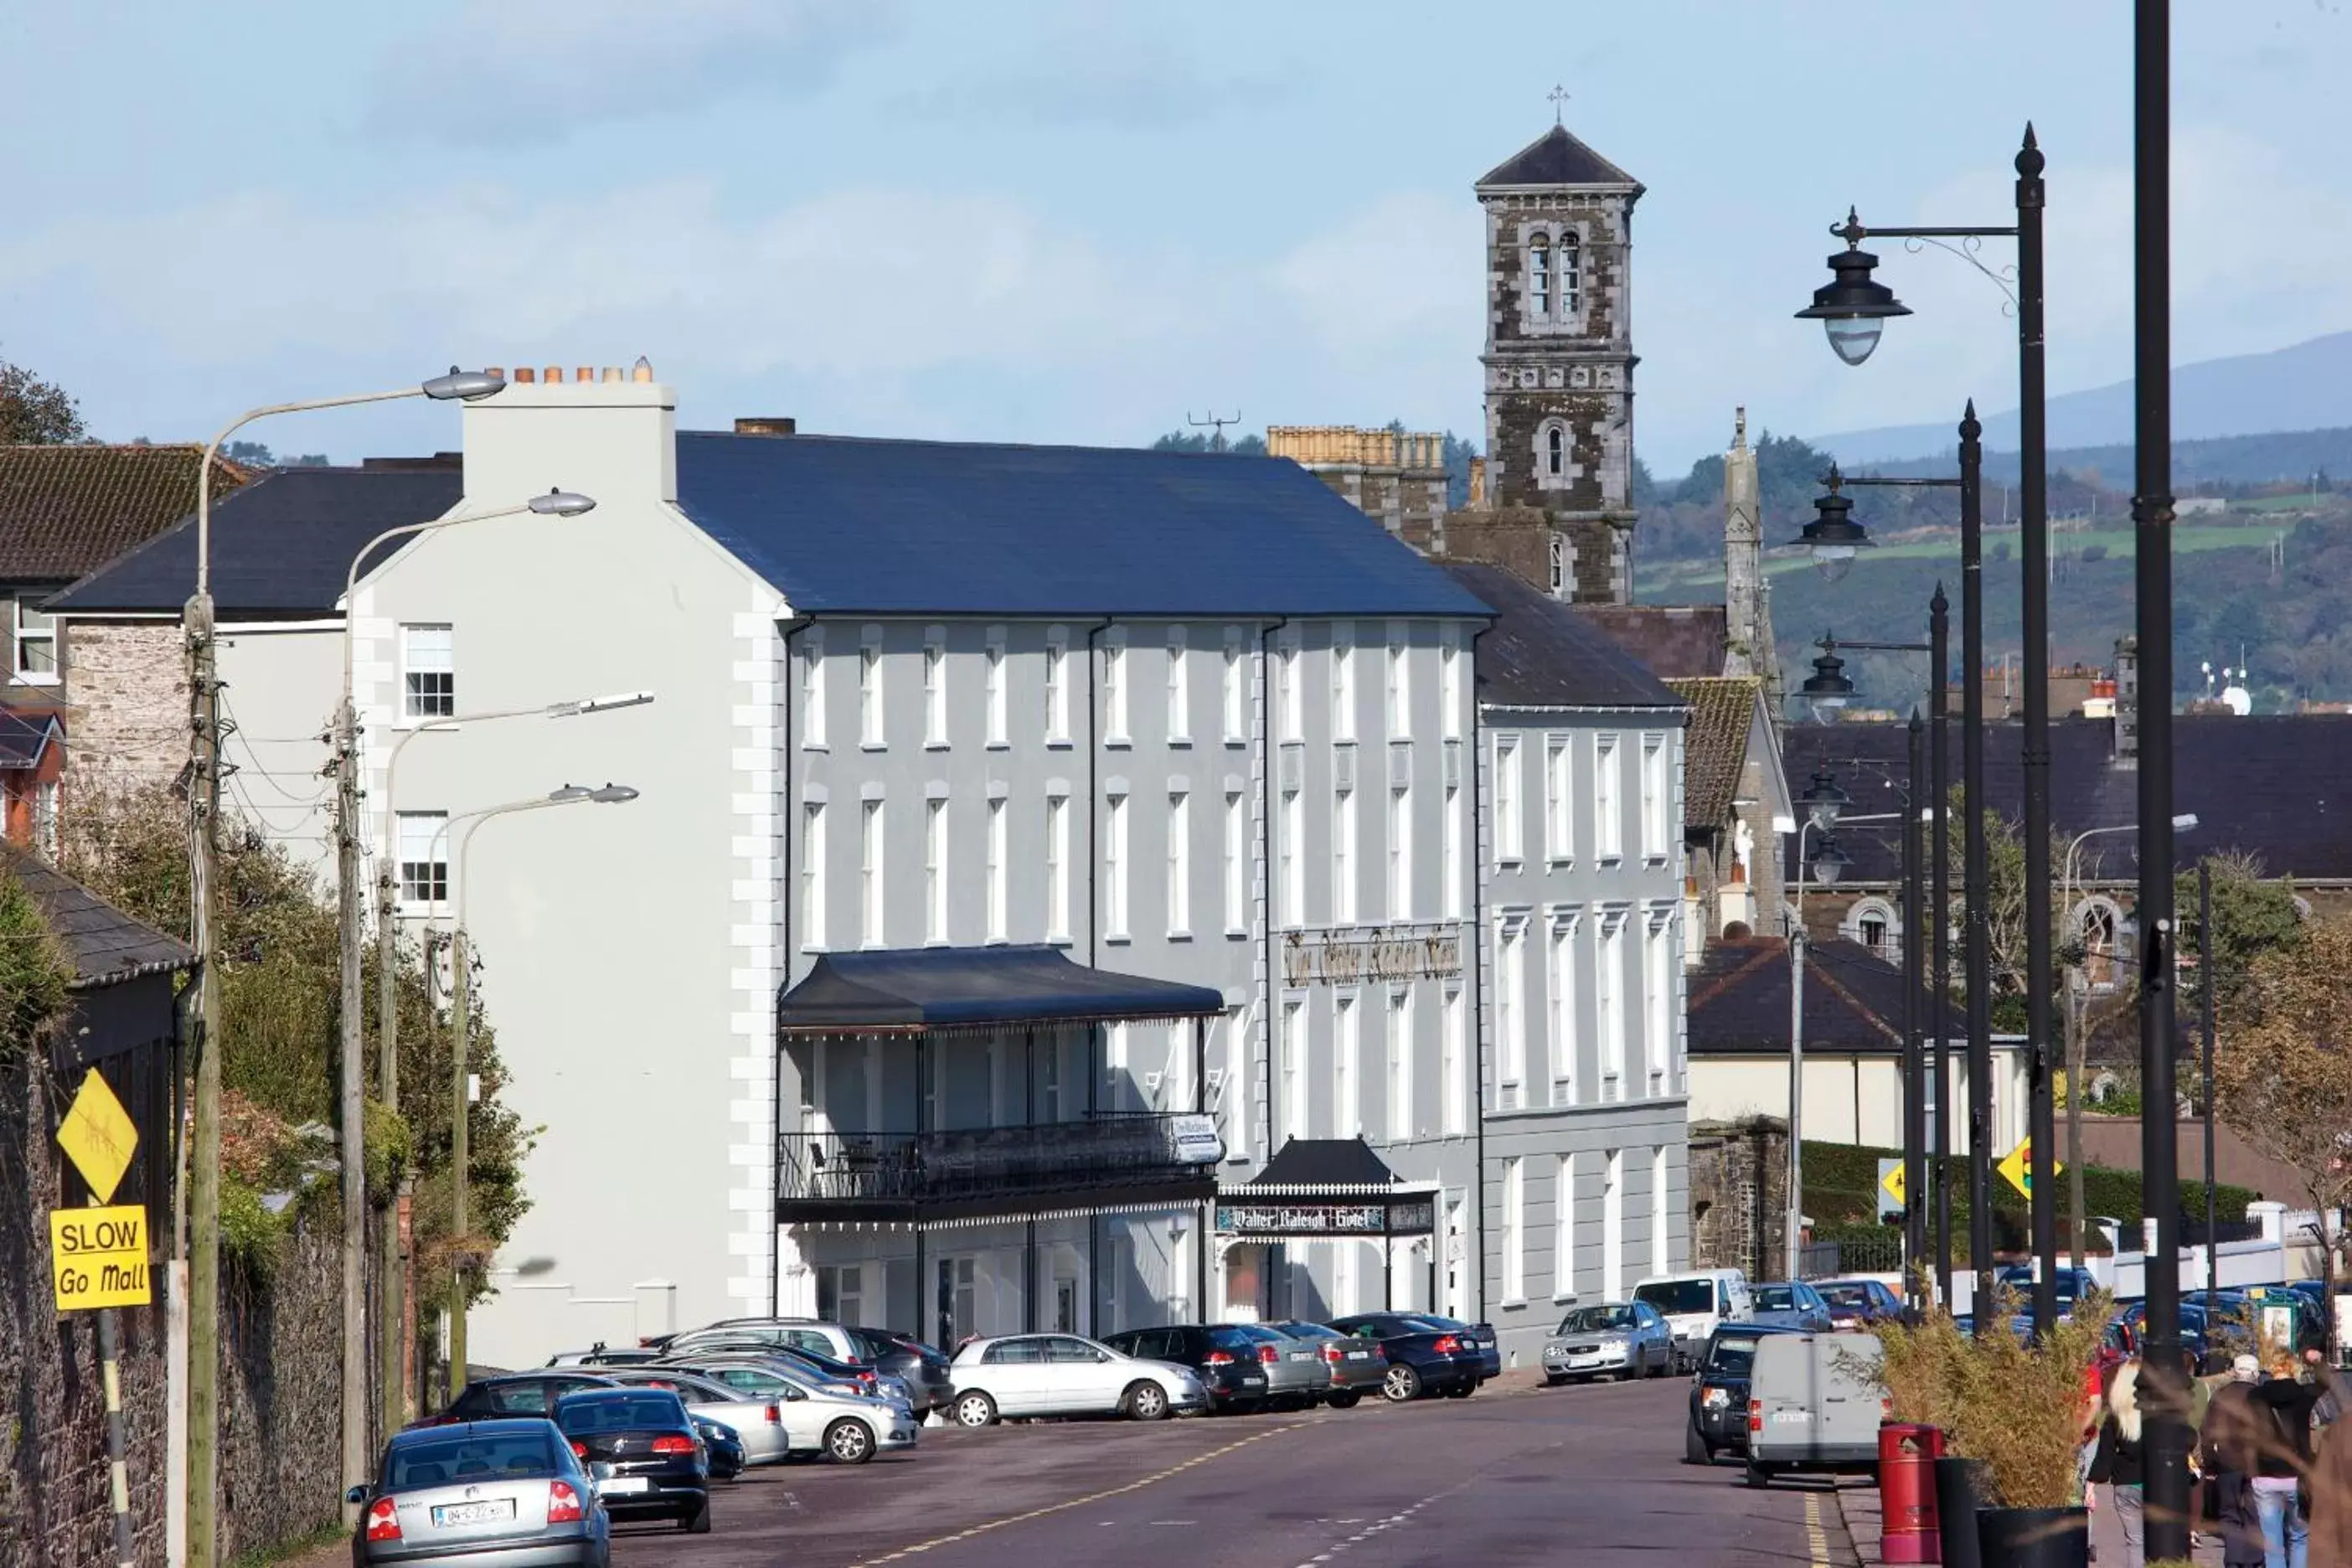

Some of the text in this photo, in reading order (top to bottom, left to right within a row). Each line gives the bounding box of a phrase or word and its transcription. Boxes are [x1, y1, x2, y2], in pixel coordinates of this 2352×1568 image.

[1279, 1208, 1327, 1230] Raleigh
[61, 1221, 138, 1251] SLOW
[60, 1263, 144, 1295] Go Mall
